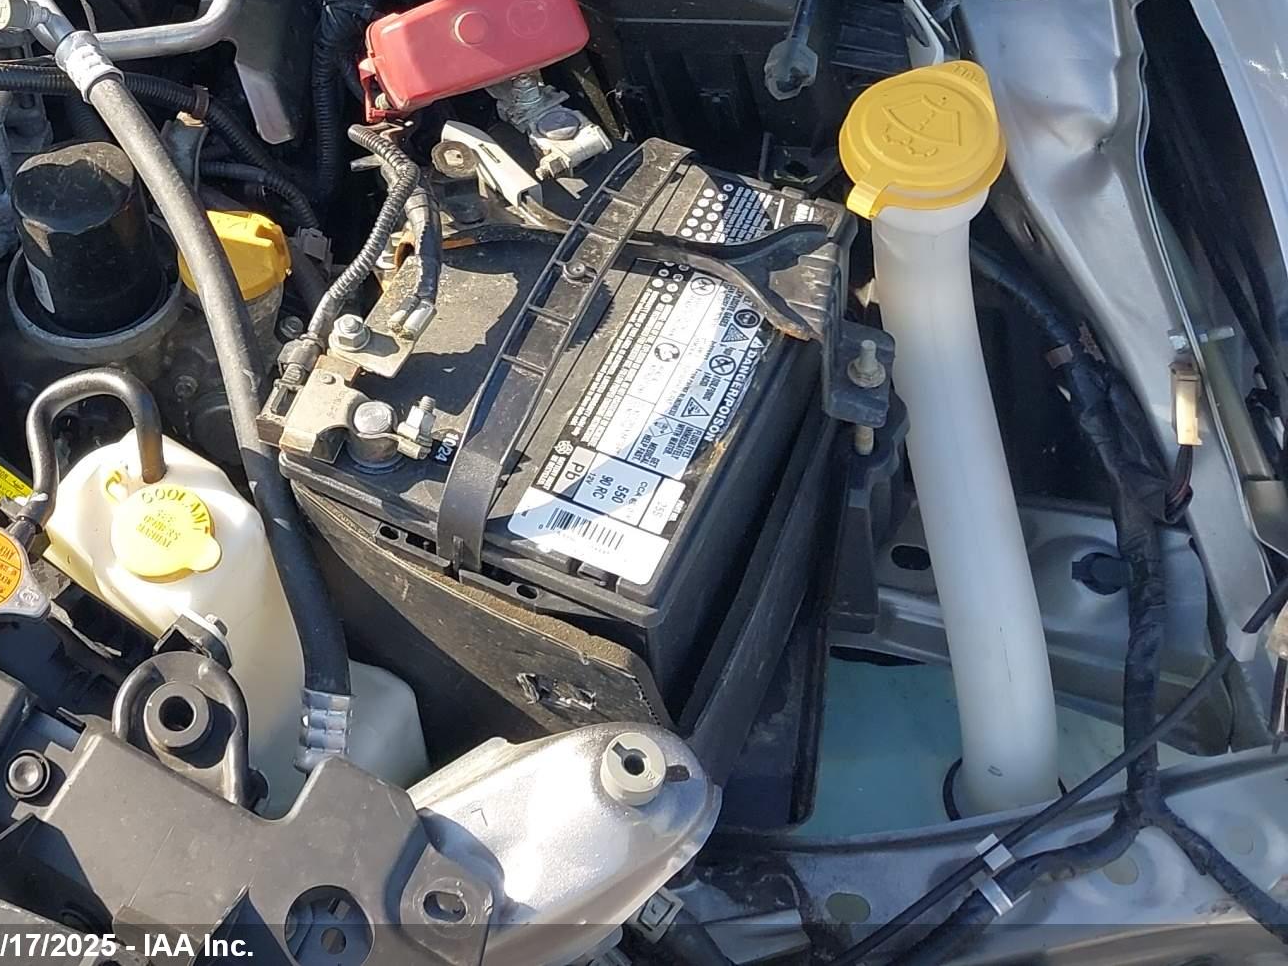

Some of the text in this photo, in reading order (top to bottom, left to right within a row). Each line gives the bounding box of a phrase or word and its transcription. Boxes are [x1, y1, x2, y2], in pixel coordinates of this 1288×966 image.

[703, 348, 759, 443] DANGER/POISON
[672, 422, 685, 437] WITH
[435, 433, 459, 462] 10/24
[639, 441, 658, 465] MEDICAL
[670, 426, 693, 459] IMMEDIATELY
[681, 428, 702, 459] FLUSH EYES
[565, 461, 584, 481] Pb
[648, 456, 660, 468] GET
[586, 472, 596, 485] 12V
[591, 474, 613, 500] 90 RC
[611, 484, 629, 504] 550
[141, 486, 212, 532] COOLANT
